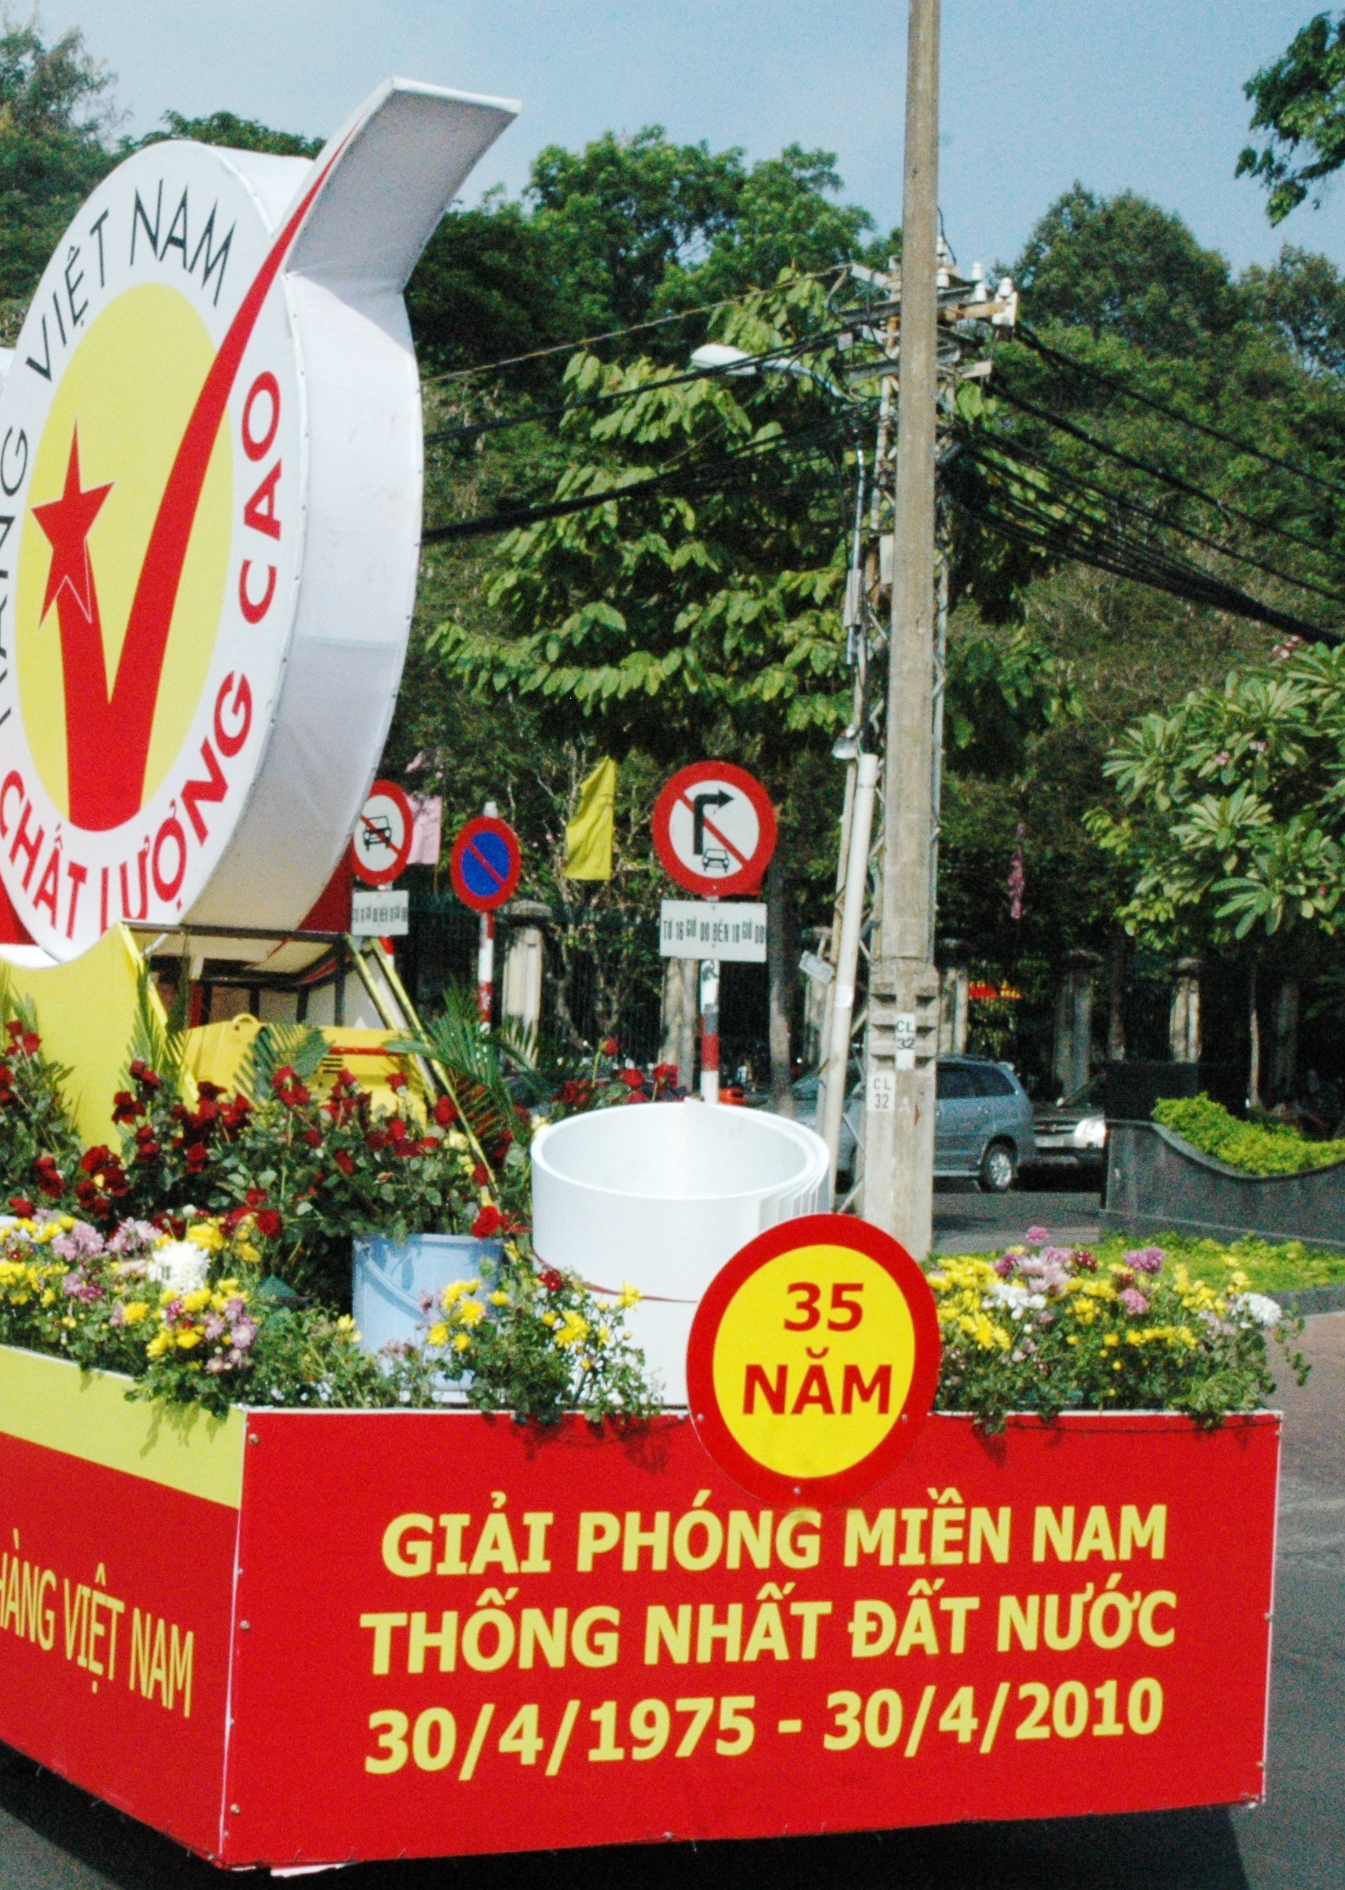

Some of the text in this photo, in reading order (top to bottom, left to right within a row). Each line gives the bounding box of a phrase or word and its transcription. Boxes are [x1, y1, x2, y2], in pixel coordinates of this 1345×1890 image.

[25, 208, 109, 382] VIỆT
[130, 178, 236, 307] NAM
[238, 371, 282, 624] CAO
[896, 1020, 915, 1033] CL
[896, 1038, 915, 1050] 32
[873, 1078, 892, 1091] CL
[874, 1093, 889, 1109] 32
[783, 1281, 865, 1332] 35
[742, 1346, 893, 1416] NĂM
[381, 1486, 1168, 1578] GIẢI PHÓNG MIỀN NAM
[63, 1562, 126, 1695] VIỆT
[129, 1606, 195, 1719] NAM
[359, 1571, 1178, 1676] THỐNG NHẤT ĐẤT NƯỚC
[363, 1676, 1165, 1782] 30/4/1975 - 30/4/2010
